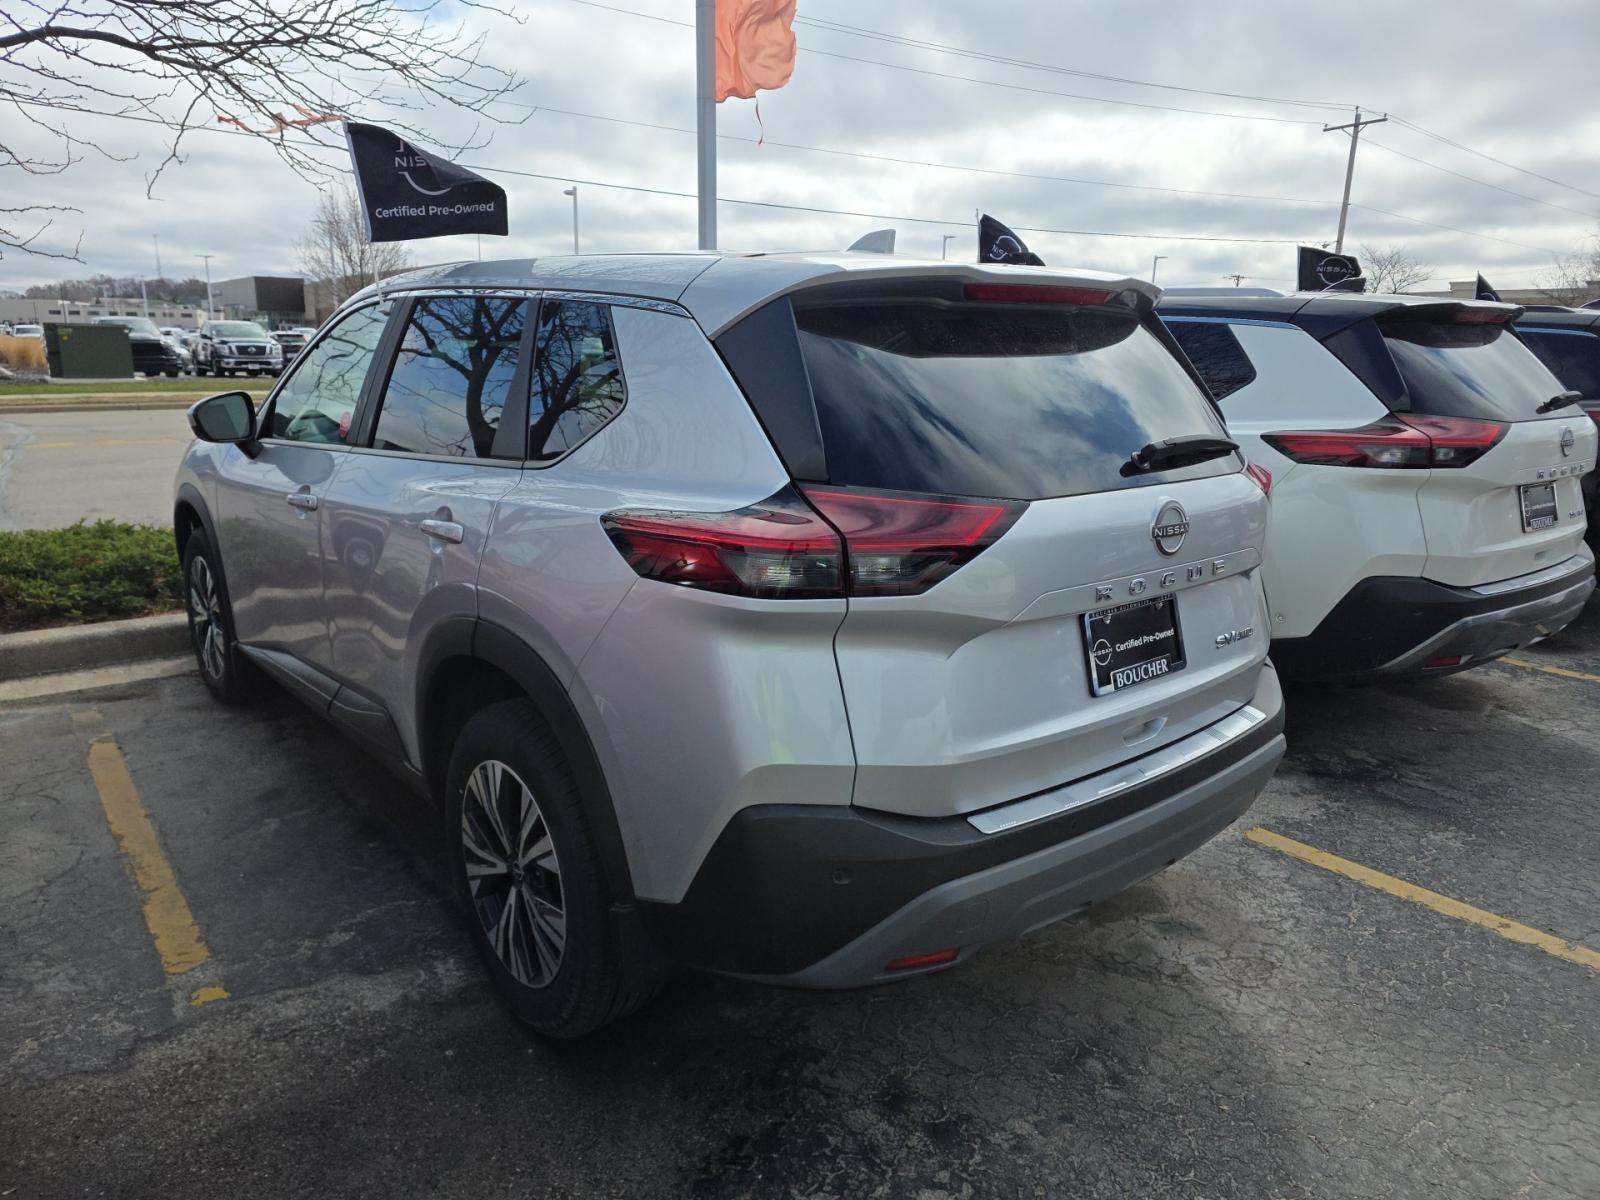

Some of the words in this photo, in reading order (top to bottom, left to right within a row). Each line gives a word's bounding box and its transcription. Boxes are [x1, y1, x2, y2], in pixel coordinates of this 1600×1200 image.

[394, 156, 427, 168] NIS
[375, 205, 426, 218] Certified
[429, 201, 495, 216] Pre-Owned
[1154, 523, 1189, 537] NISSAN
[1095, 560, 1225, 603] ROGUE
[1115, 637, 1143, 652] Certified
[1143, 628, 1175, 644] Pre-Owned
[1215, 630, 1236, 649] SV
[1116, 658, 1169, 688] BOUCHER
